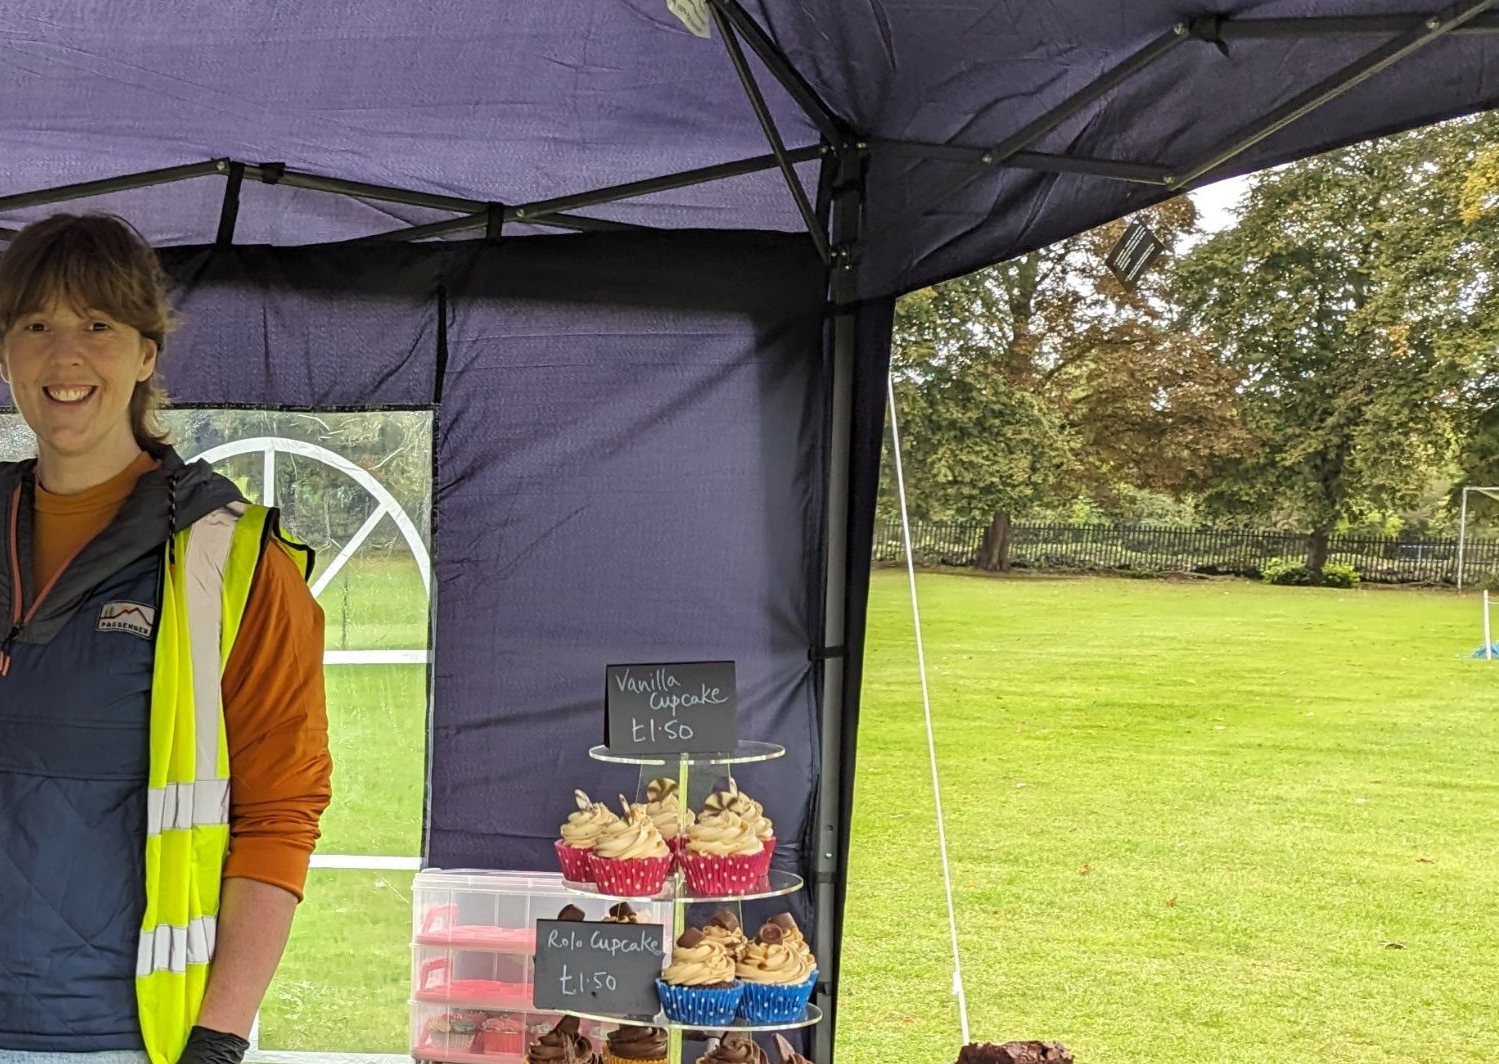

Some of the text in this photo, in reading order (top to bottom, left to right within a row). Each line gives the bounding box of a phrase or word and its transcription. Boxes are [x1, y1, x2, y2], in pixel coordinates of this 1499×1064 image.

[101, 621, 149, 634] PASSENGER
[615, 667, 682, 694] Vanilla
[547, 928, 664, 957] Rolo Cupcake
